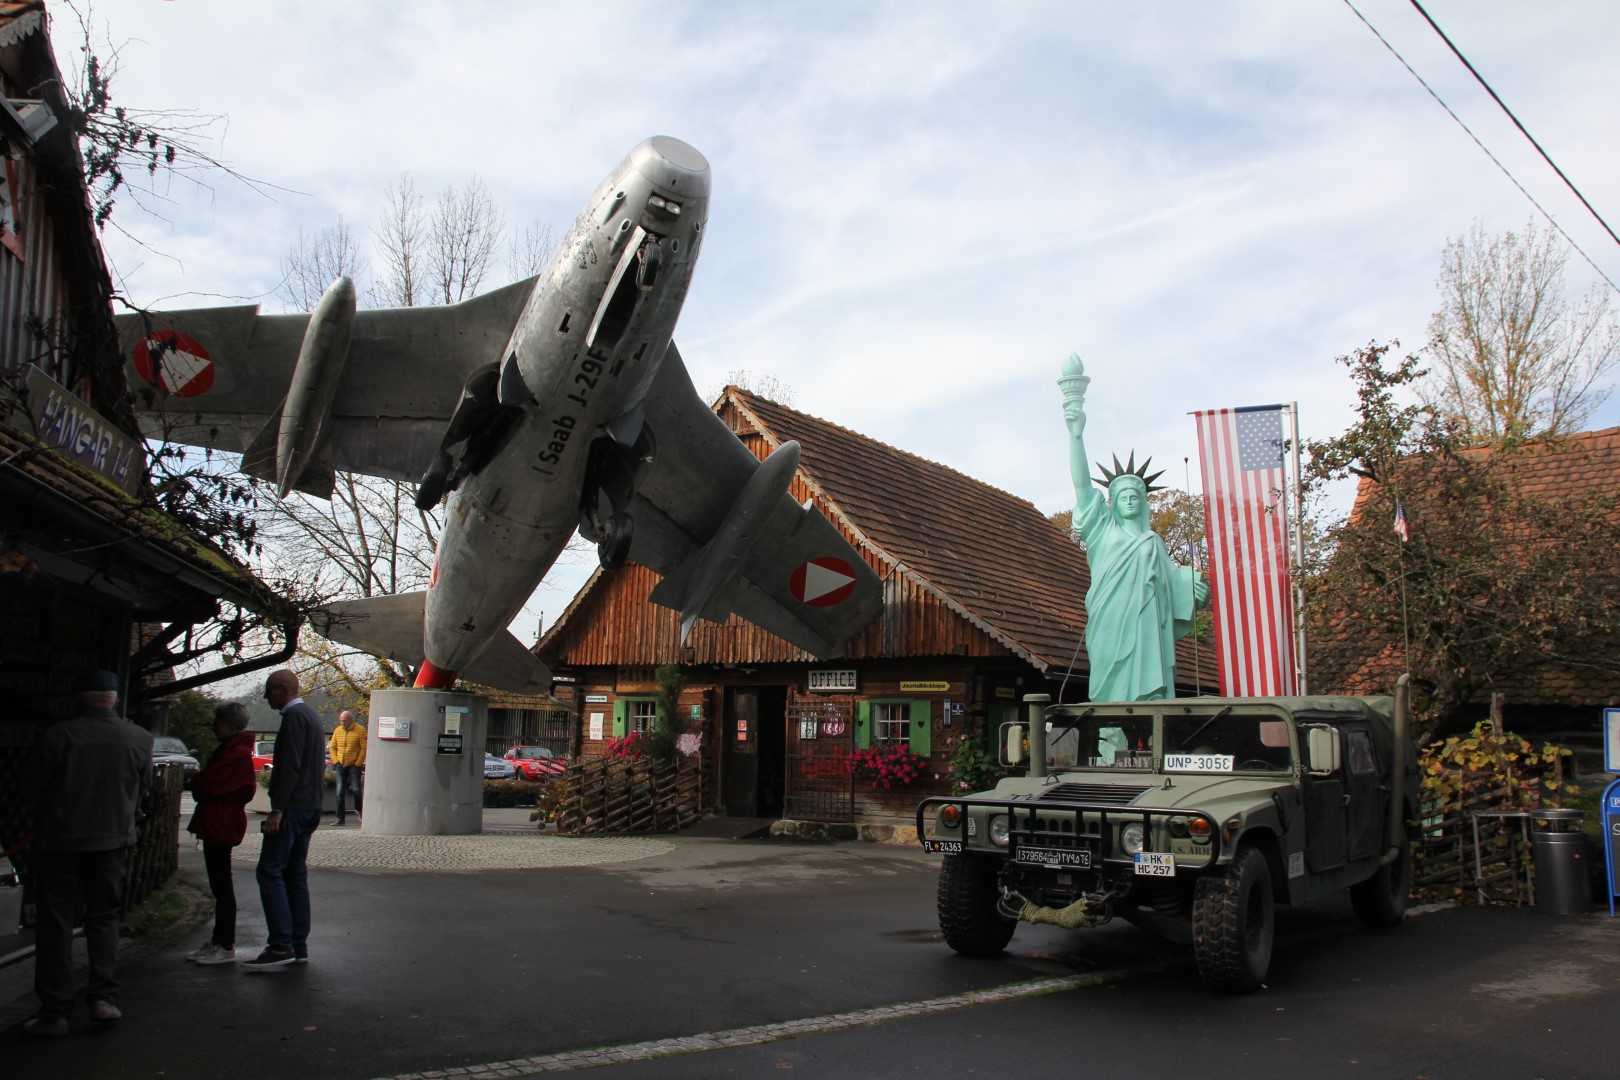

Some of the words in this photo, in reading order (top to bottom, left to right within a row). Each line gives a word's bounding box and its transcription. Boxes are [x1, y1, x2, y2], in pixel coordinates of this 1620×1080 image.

[538, 415, 577, 465] Saab
[567, 345, 609, 408] J-29F
[40, 390, 113, 472] HANGAR
[111, 440, 134, 482] 14
[811, 672, 855, 687] OFFICE
[1115, 757, 1151, 769] ARMY
[924, 841, 934, 851] FL
[939, 841, 962, 852] 24363
[1188, 846, 1213, 855] ARM
[1150, 855, 1162, 865] HK
[1138, 865, 1150, 874] HC
[1153, 865, 1171, 875] 257
